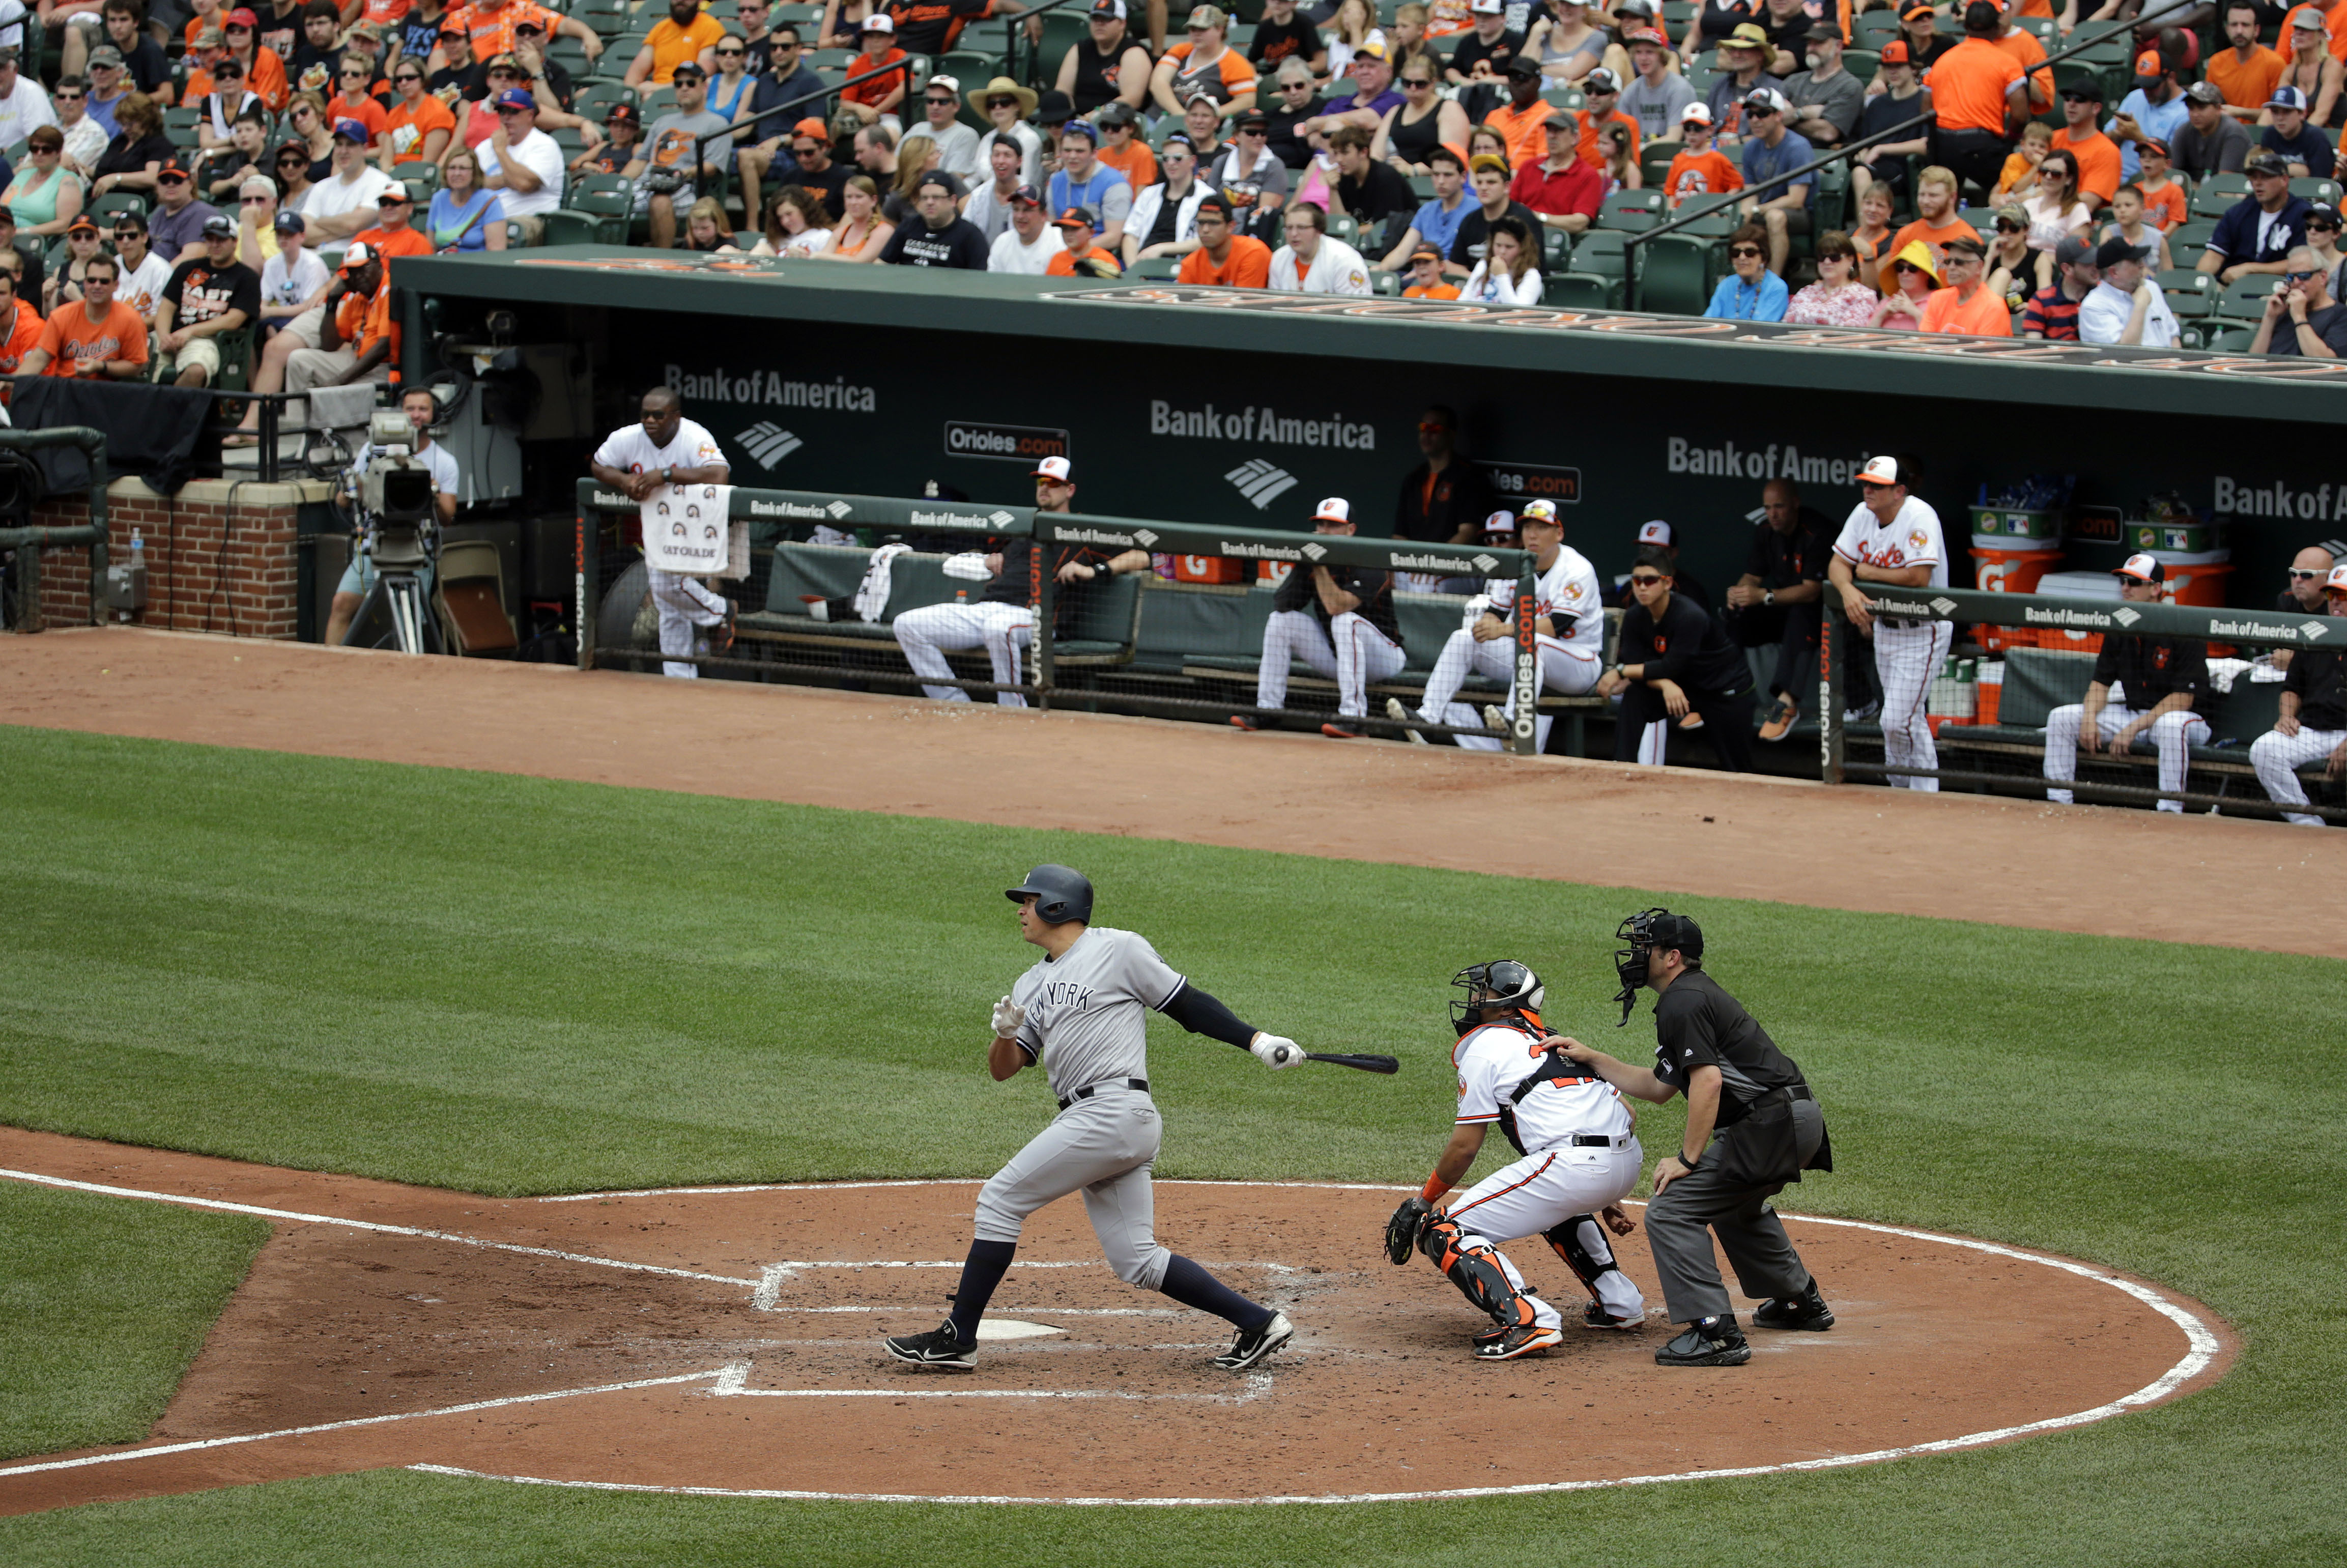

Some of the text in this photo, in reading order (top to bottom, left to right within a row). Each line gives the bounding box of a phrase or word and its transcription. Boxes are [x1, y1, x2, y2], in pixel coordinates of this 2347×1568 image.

[665, 363, 875, 412] Bank of America
[1151, 399, 1375, 450] Bank of America
[949, 427, 1064, 456] Orioles.com
[1668, 436, 1743, 478] Bank
[1745, 444, 1778, 479] of
[593, 490, 619, 505] Bank
[2215, 475, 2294, 518] Bank
[2297, 483, 2331, 521] of
[751, 500, 825, 519] Bank of America
[911, 510, 988, 528] Bank of America
[1054, 526, 1134, 547] Bank of America
[1221, 541, 1301, 559] Bank of America
[1390, 553, 1472, 572] Bank of America
[1884, 598, 1930, 616] America
[2025, 607, 2111, 627] Bank of America
[2210, 619, 2298, 640] Bank of America
[1515, 595, 1533, 738] Orioles.com
[1046, 981, 1096, 1012] YORK
